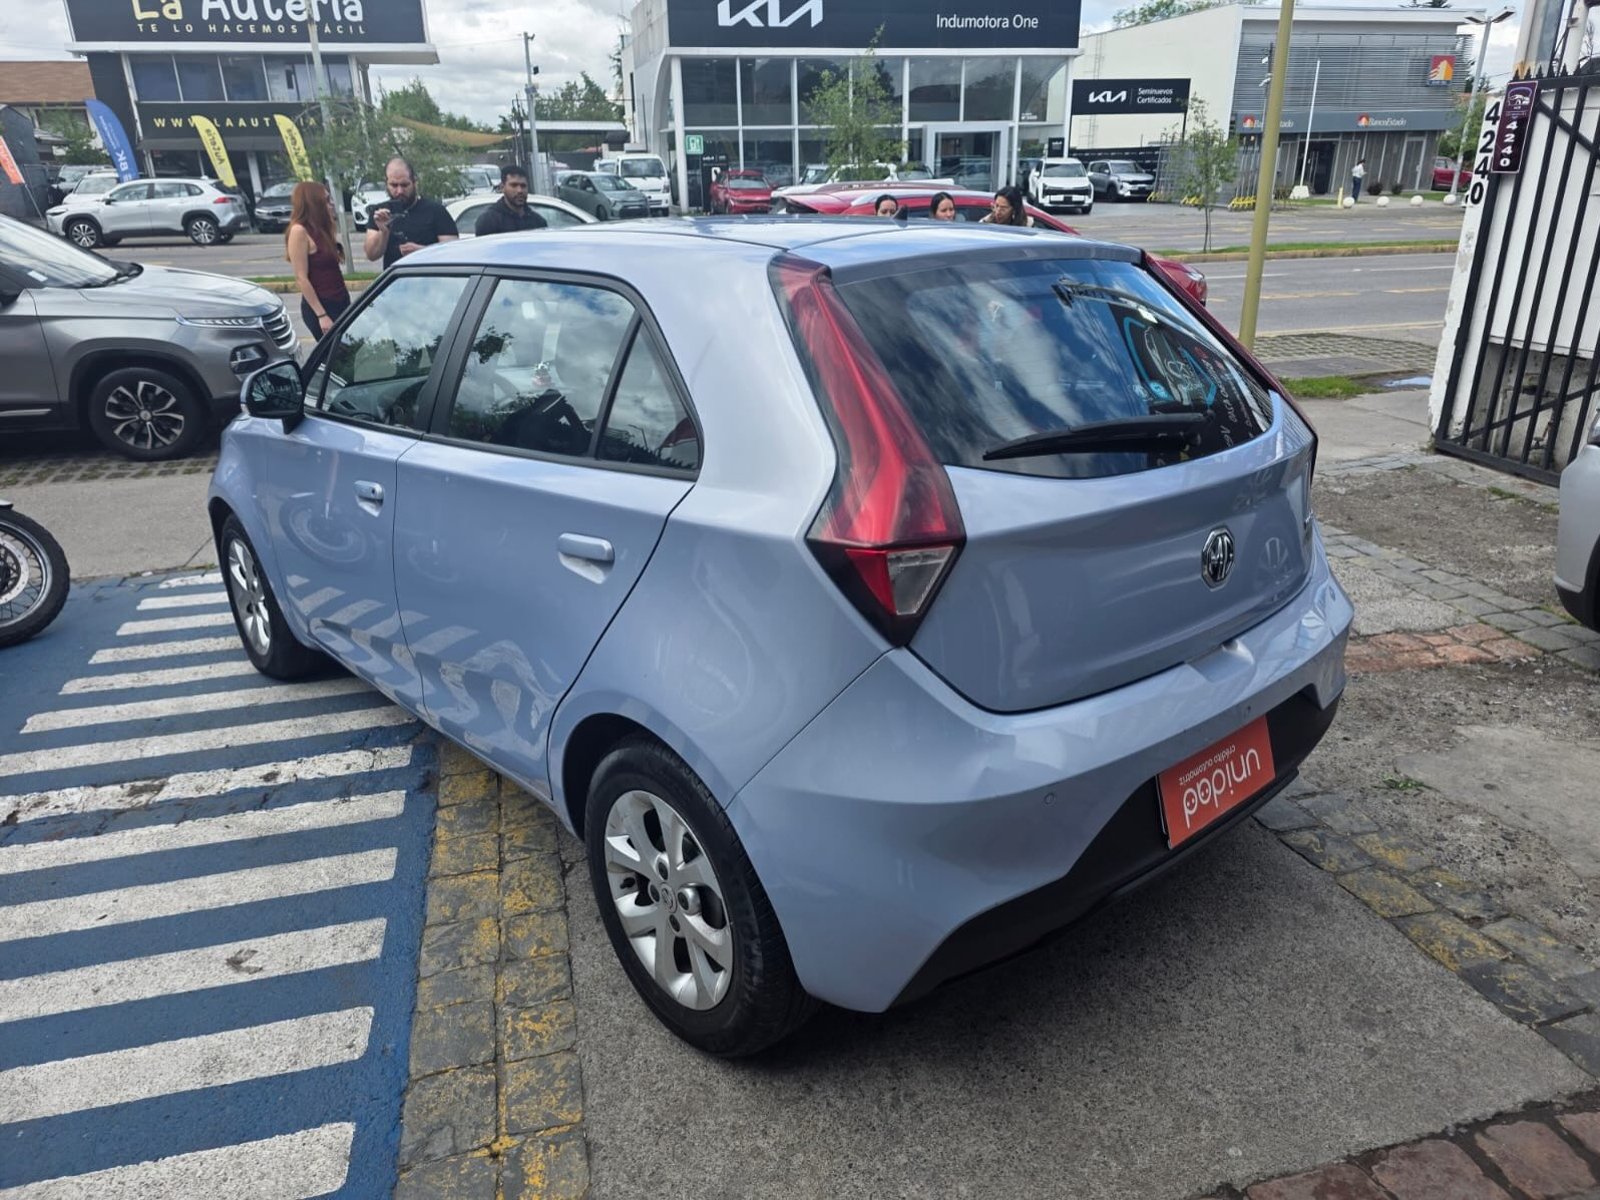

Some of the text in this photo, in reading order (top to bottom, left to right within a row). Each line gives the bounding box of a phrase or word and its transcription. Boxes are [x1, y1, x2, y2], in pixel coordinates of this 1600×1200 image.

[131, 0, 183, 20] La
[717, 0, 823, 28] KIA
[137, 22, 366, 35] TE LO HACEMOS ÁCIL
[936, 13, 1039, 29] Indumotora One
[1088, 90, 1127, 103] KIA
[1499, 120, 1519, 168] 4240
[1182, 748, 1261, 830] unidad
